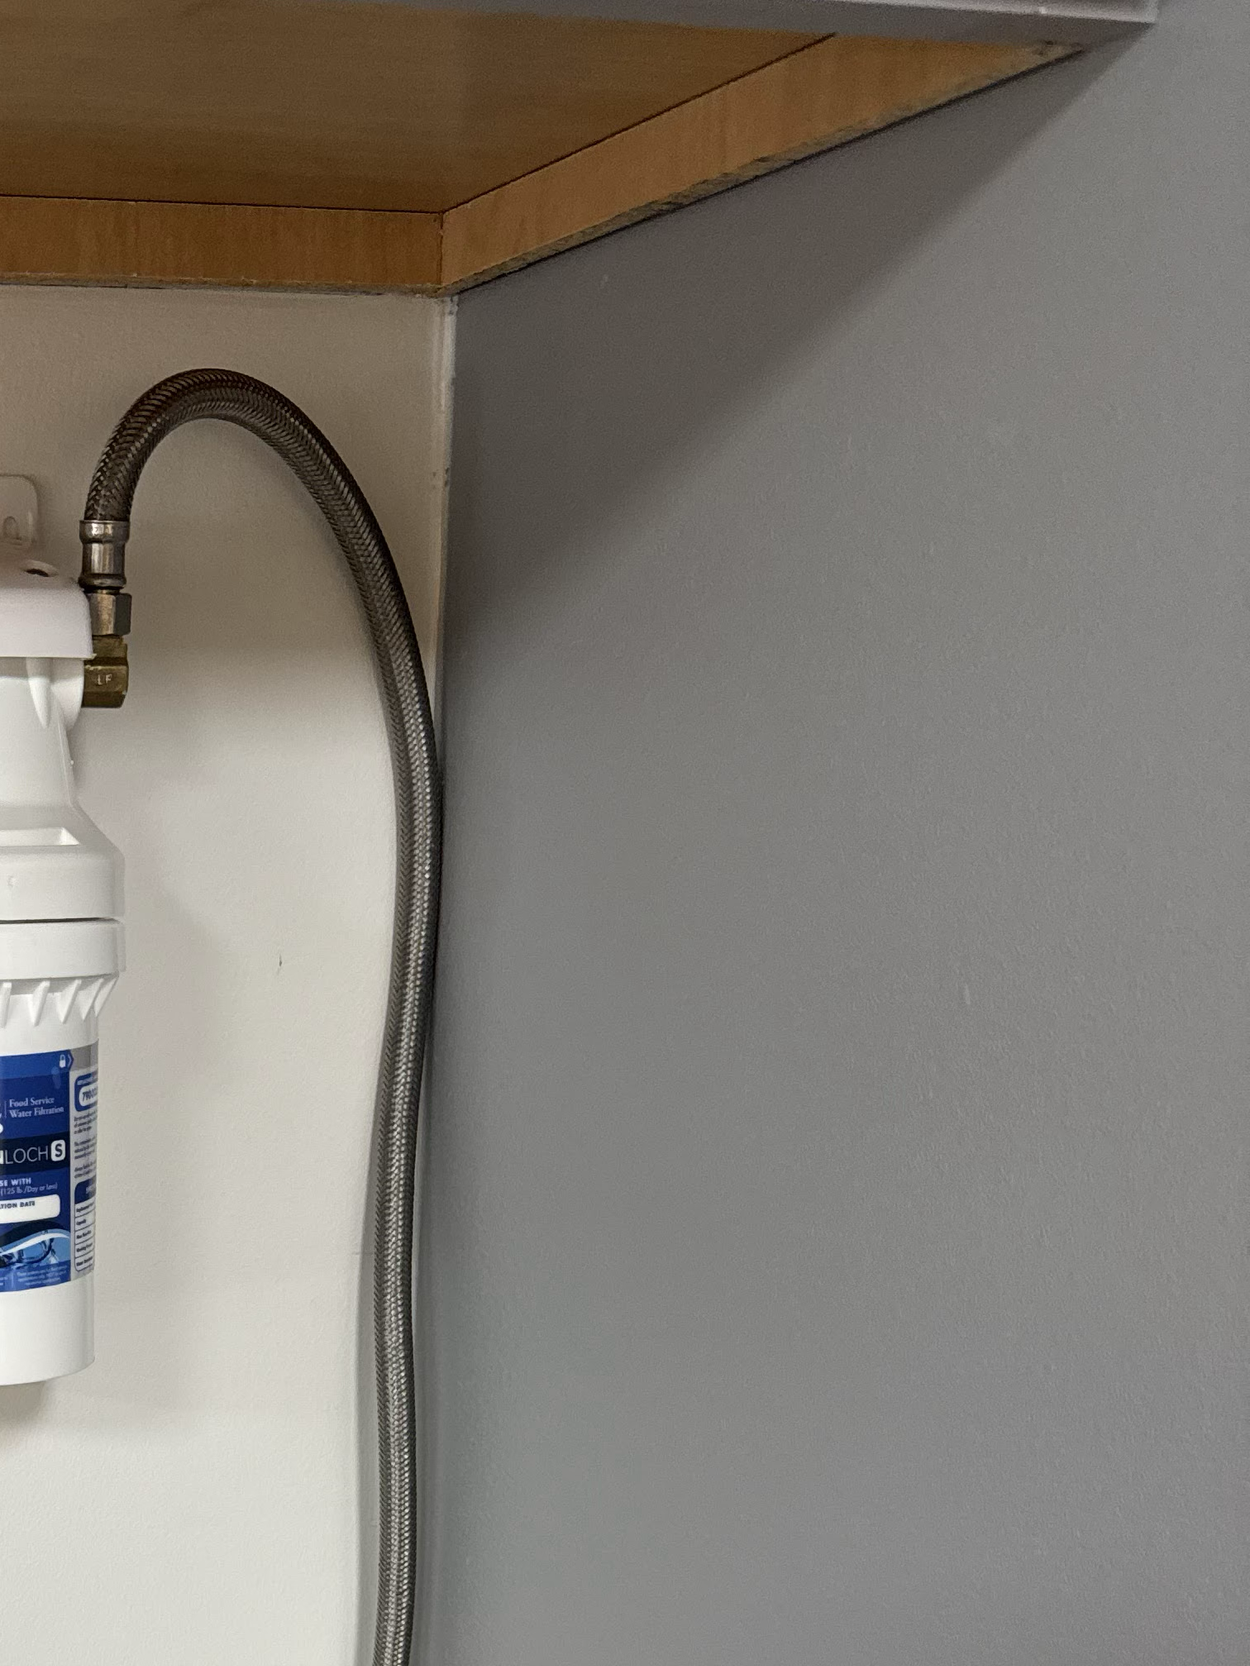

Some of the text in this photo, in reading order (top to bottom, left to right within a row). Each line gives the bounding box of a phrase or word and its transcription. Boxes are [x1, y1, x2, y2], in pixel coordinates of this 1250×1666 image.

[9, 1097, 54, 1108] Food Service
[9, 1106, 64, 1118] Water Filtration
[12, 1178, 31, 1186] WITH
[0, 1188, 14, 1196] (125
